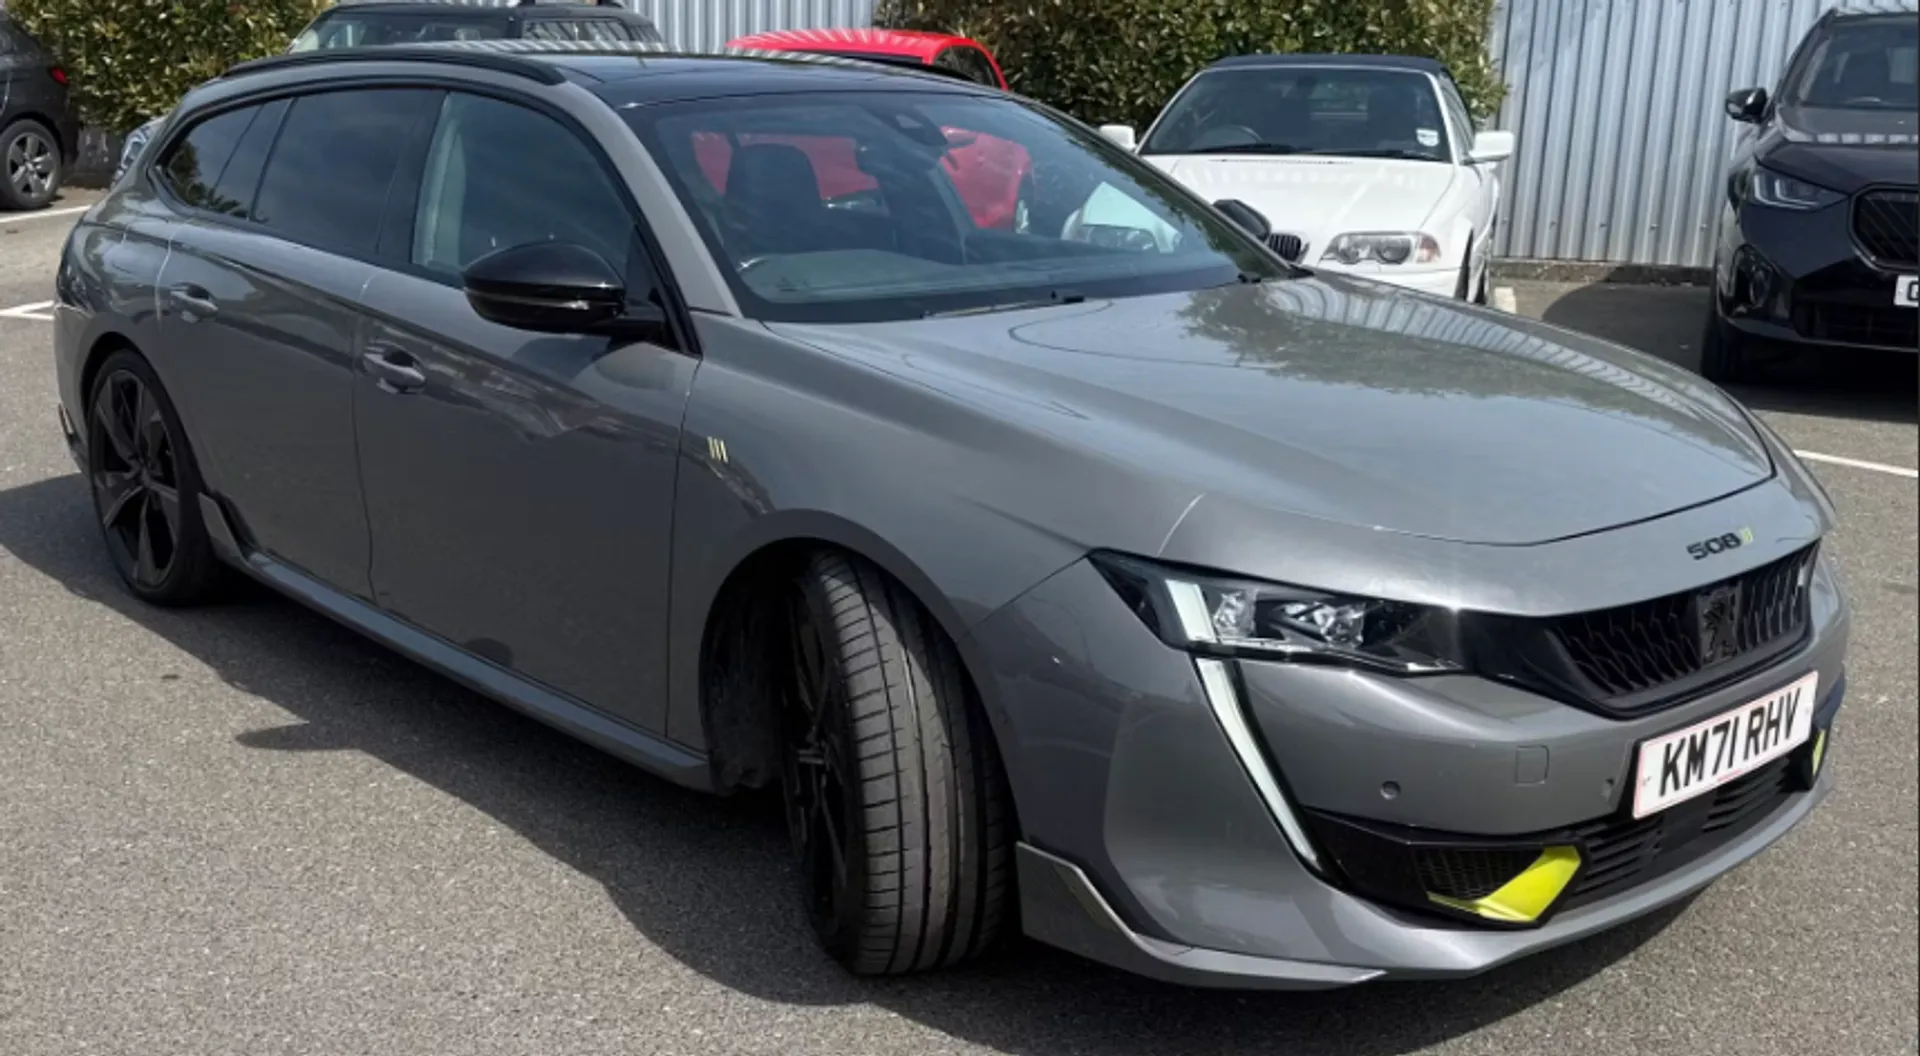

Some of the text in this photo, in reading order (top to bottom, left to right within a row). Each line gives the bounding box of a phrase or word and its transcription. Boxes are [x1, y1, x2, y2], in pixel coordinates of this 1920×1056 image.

[1686, 532, 1741, 560] 508
[1660, 687, 1801, 797] KM71 RHV
